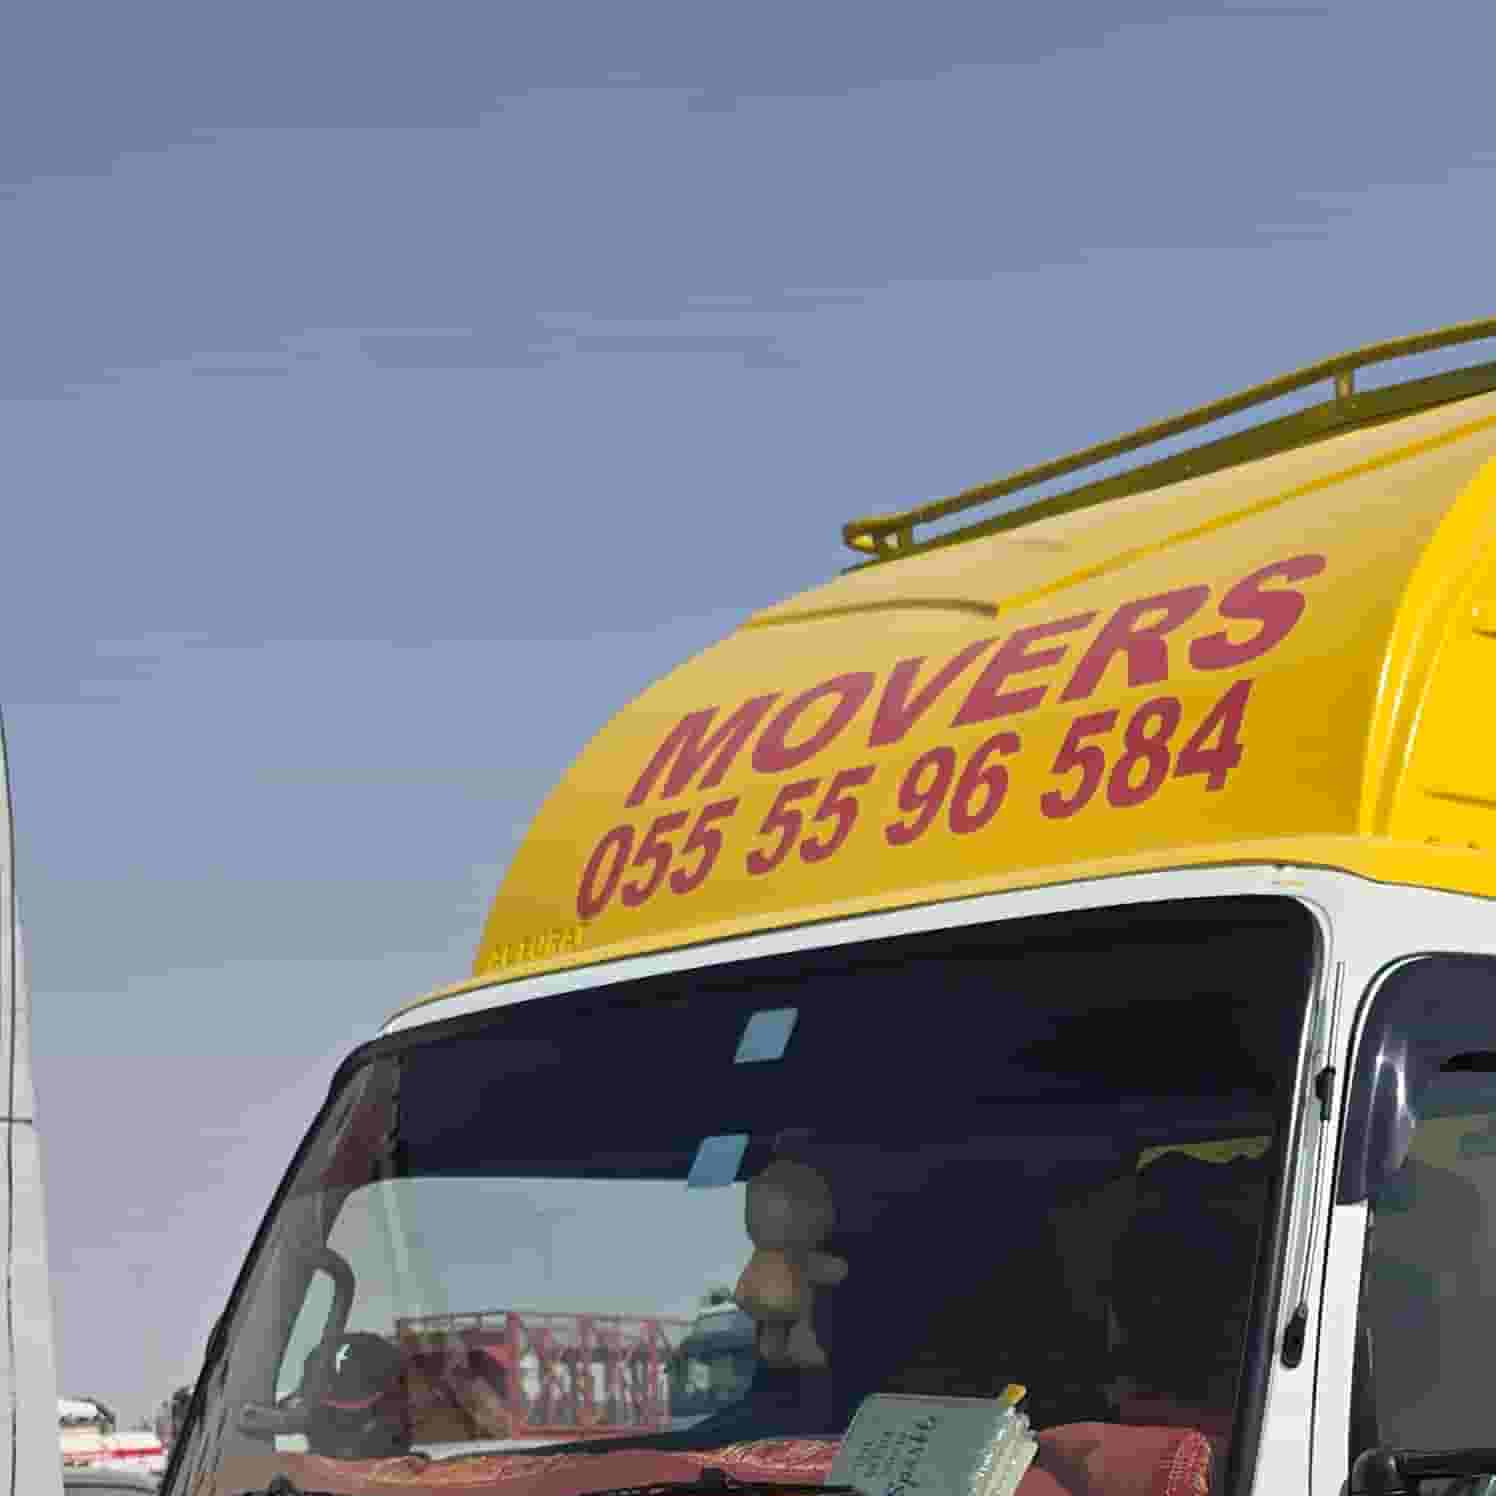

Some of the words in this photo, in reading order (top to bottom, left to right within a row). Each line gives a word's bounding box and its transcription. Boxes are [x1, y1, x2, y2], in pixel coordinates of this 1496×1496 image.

[575, 797, 738, 920] 055
[745, 765, 877, 876] 55
[883, 730, 1021, 848] 96
[1038, 678, 1255, 820] 584
[624, 554, 1327, 807] MOVERS
